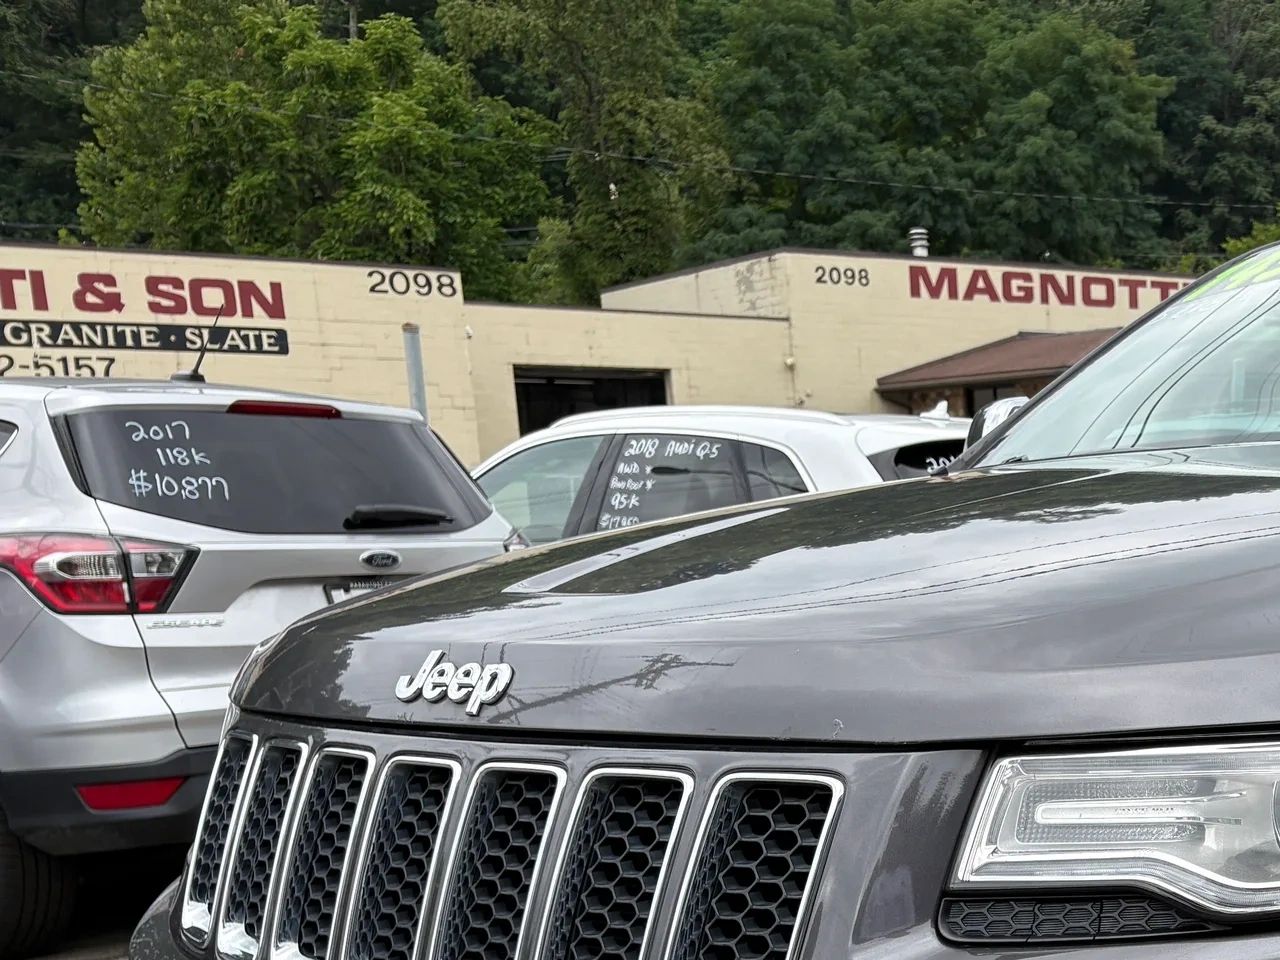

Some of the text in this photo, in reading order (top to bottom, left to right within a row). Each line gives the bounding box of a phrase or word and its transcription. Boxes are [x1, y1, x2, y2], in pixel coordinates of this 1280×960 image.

[366, 270, 457, 297] 2098
[814, 266, 870, 287] 2098
[908, 265, 1191, 310] MAGNOTT
[72, 273, 125, 314] &
[145, 276, 286, 320] SON
[3, 321, 282, 351] GRANITE SLATE
[125, 420, 190, 442] 2017
[624, 438, 659, 458] 2018
[395, 650, 515, 716] Jeep
